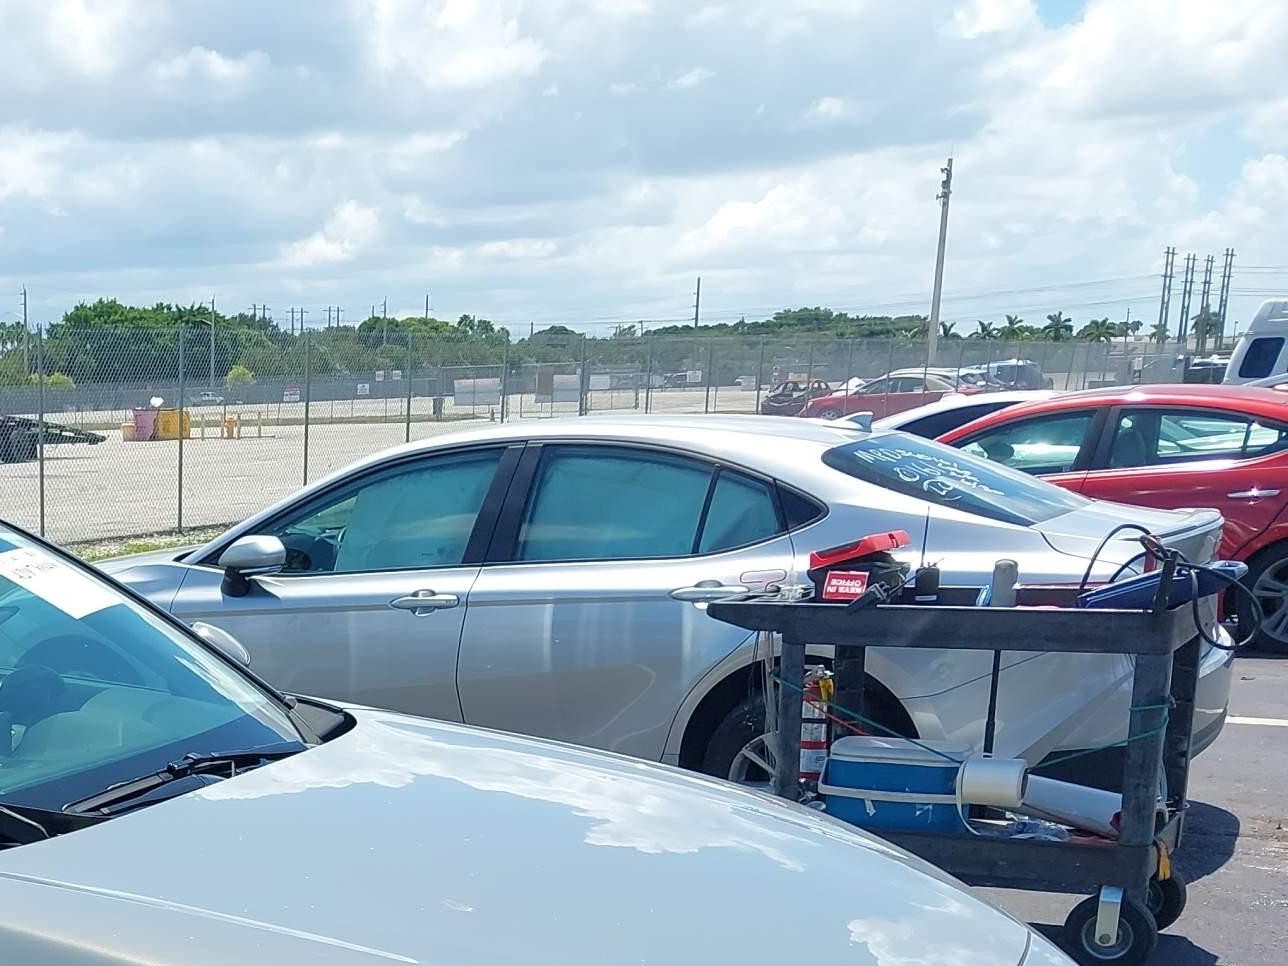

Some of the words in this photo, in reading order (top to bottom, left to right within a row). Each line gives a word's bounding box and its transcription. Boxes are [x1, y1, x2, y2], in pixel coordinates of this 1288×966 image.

[830, 578, 862, 586] OFFICE
[826, 585, 837, 593] IN
[838, 586, 862, 594] KEYS
